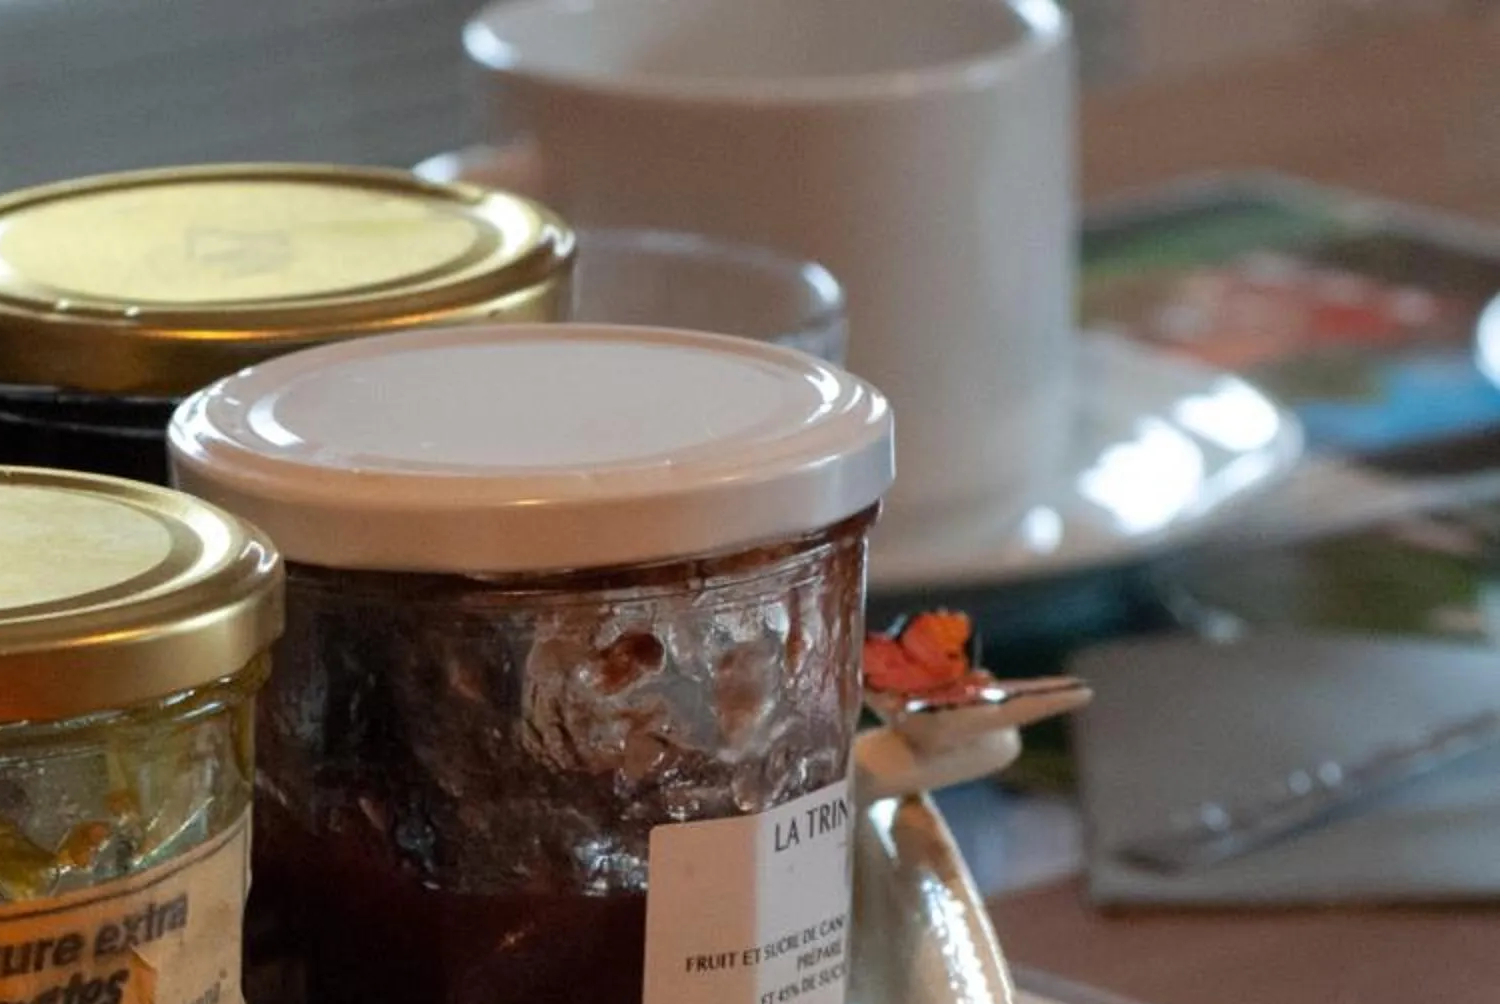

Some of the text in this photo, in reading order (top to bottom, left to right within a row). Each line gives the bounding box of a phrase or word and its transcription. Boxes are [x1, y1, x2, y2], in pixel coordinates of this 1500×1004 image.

[774, 816, 800, 853] LA
[94, 892, 189, 955] extra
[686, 950, 739, 974] FRUIT
[742, 947, 762, 969] ET
